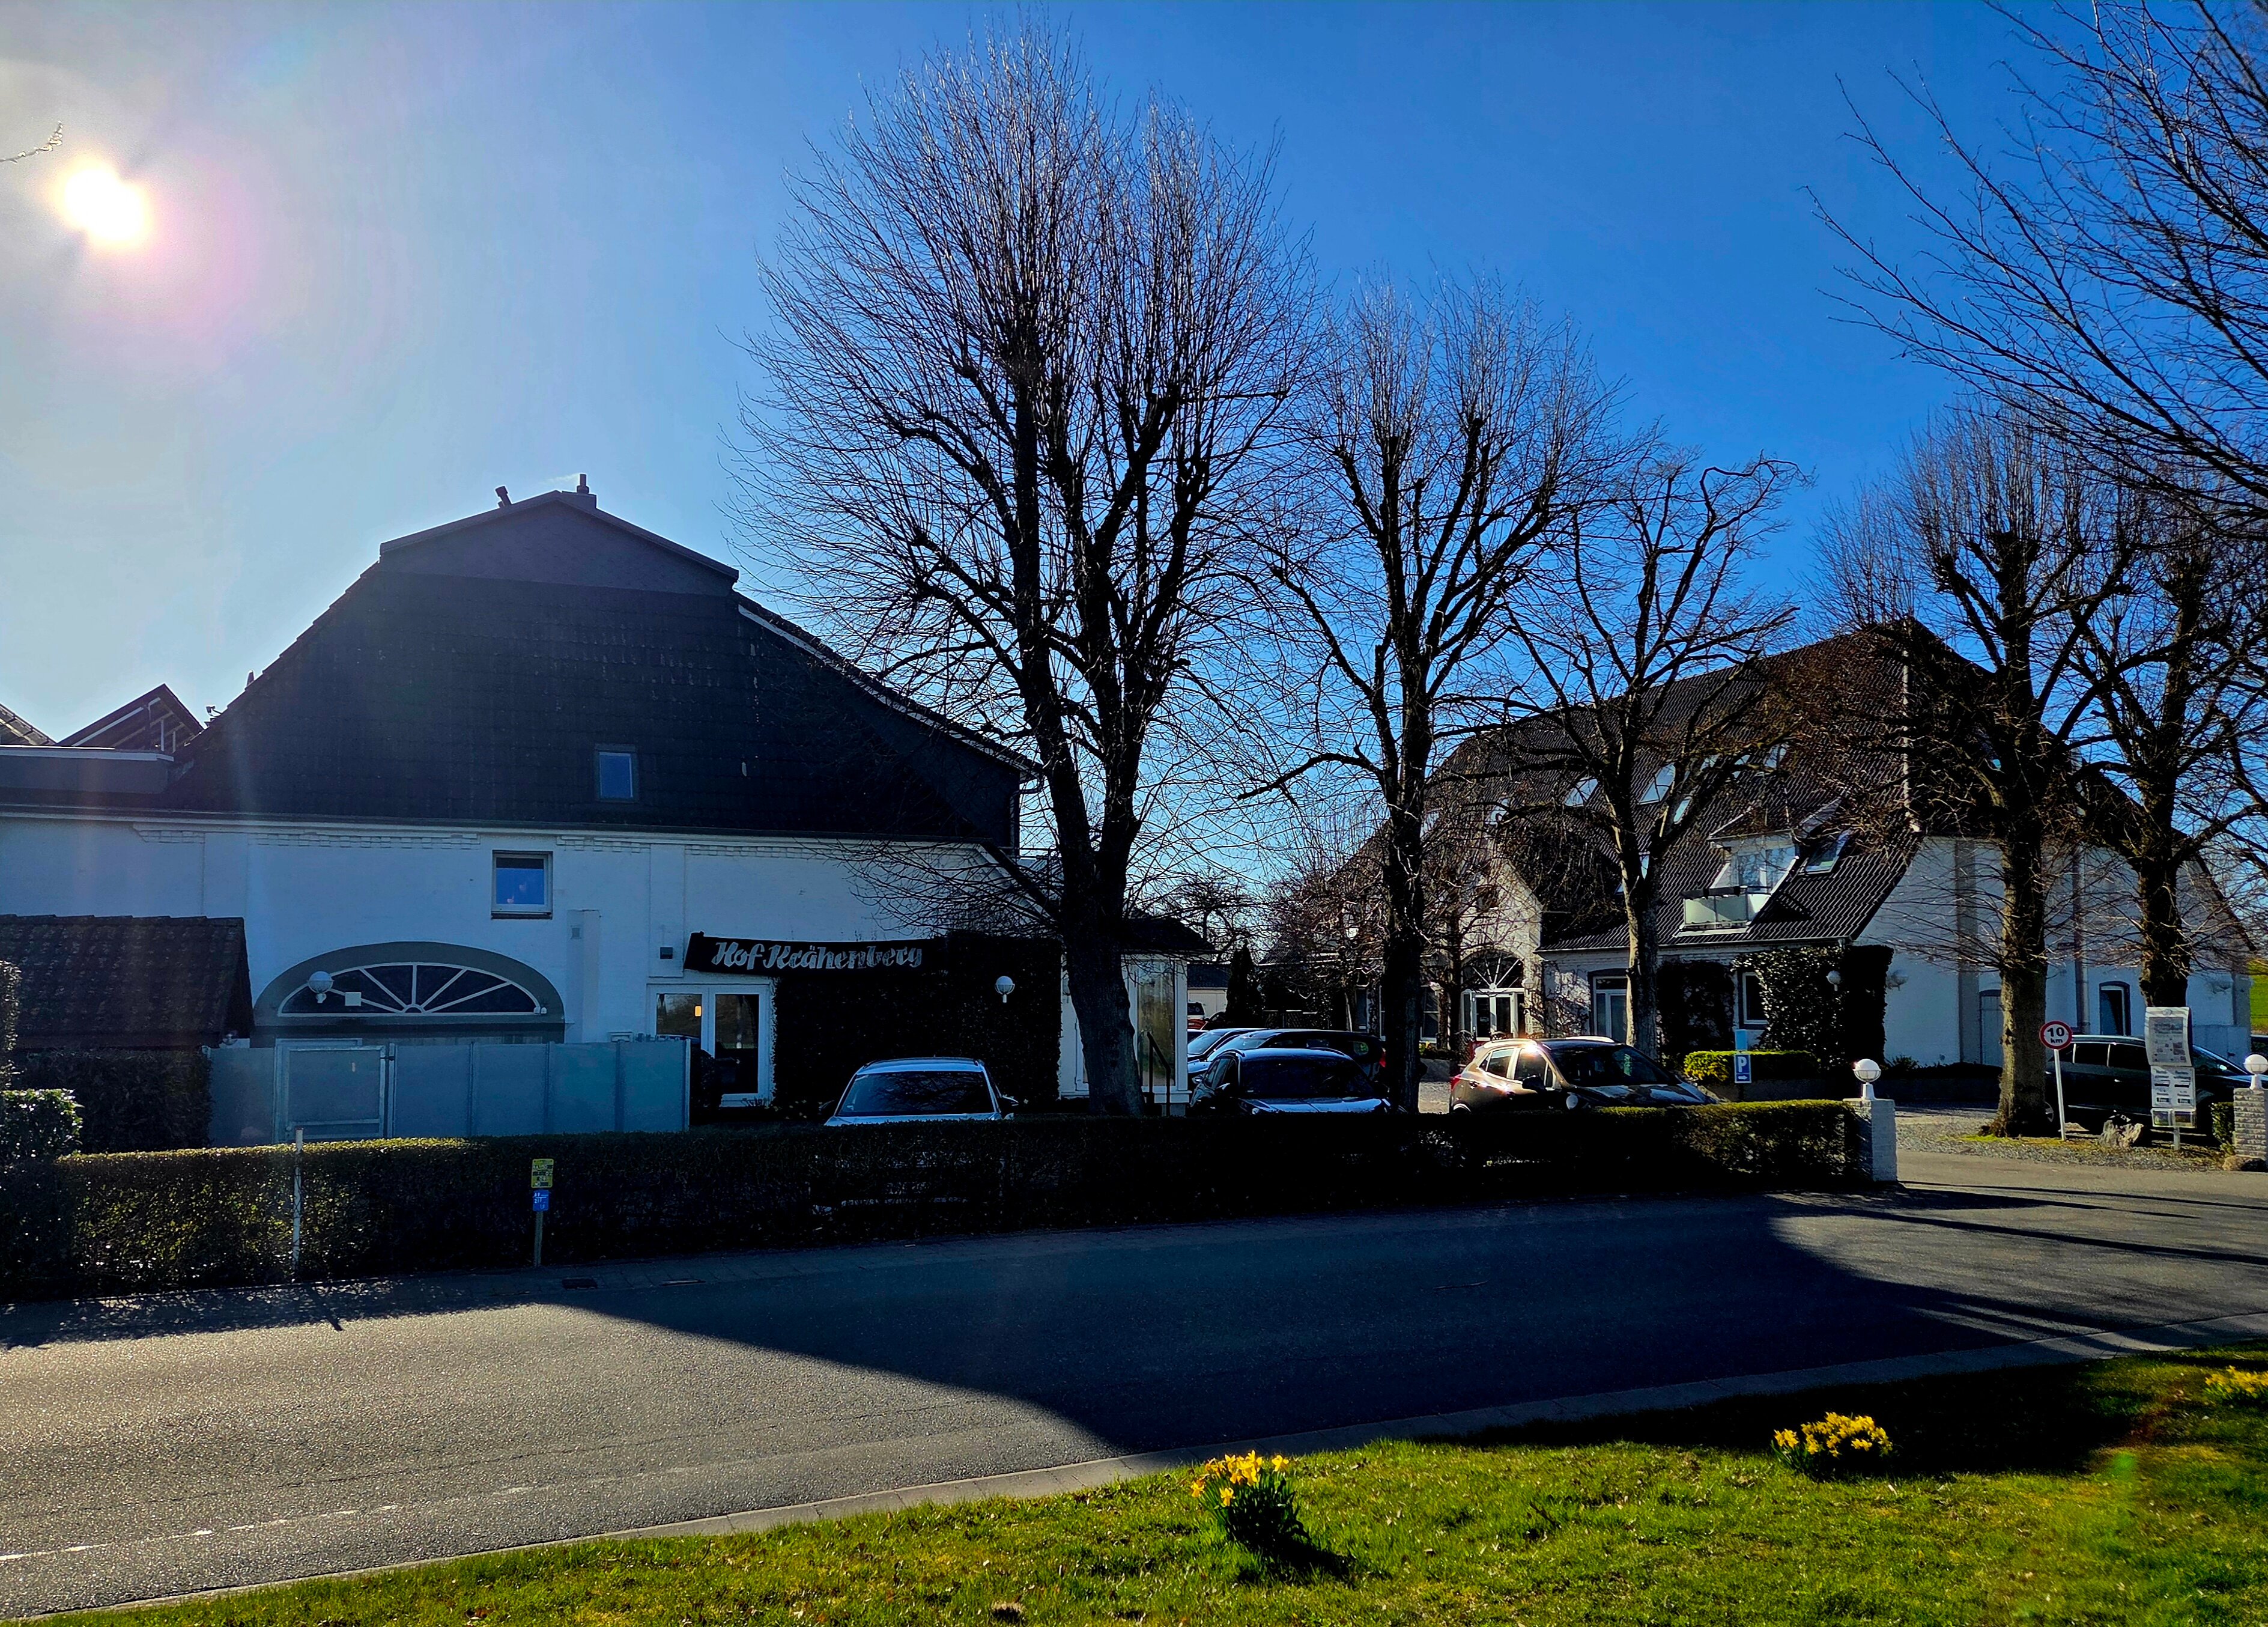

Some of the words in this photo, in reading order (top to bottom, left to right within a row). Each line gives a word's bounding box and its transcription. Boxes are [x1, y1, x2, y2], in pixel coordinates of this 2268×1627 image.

[711, 941, 765, 970] Hof
[763, 944, 922, 969] Krähenberg
[2047, 1027, 2064, 1037] 10
[1738, 1056, 1747, 1072] P
